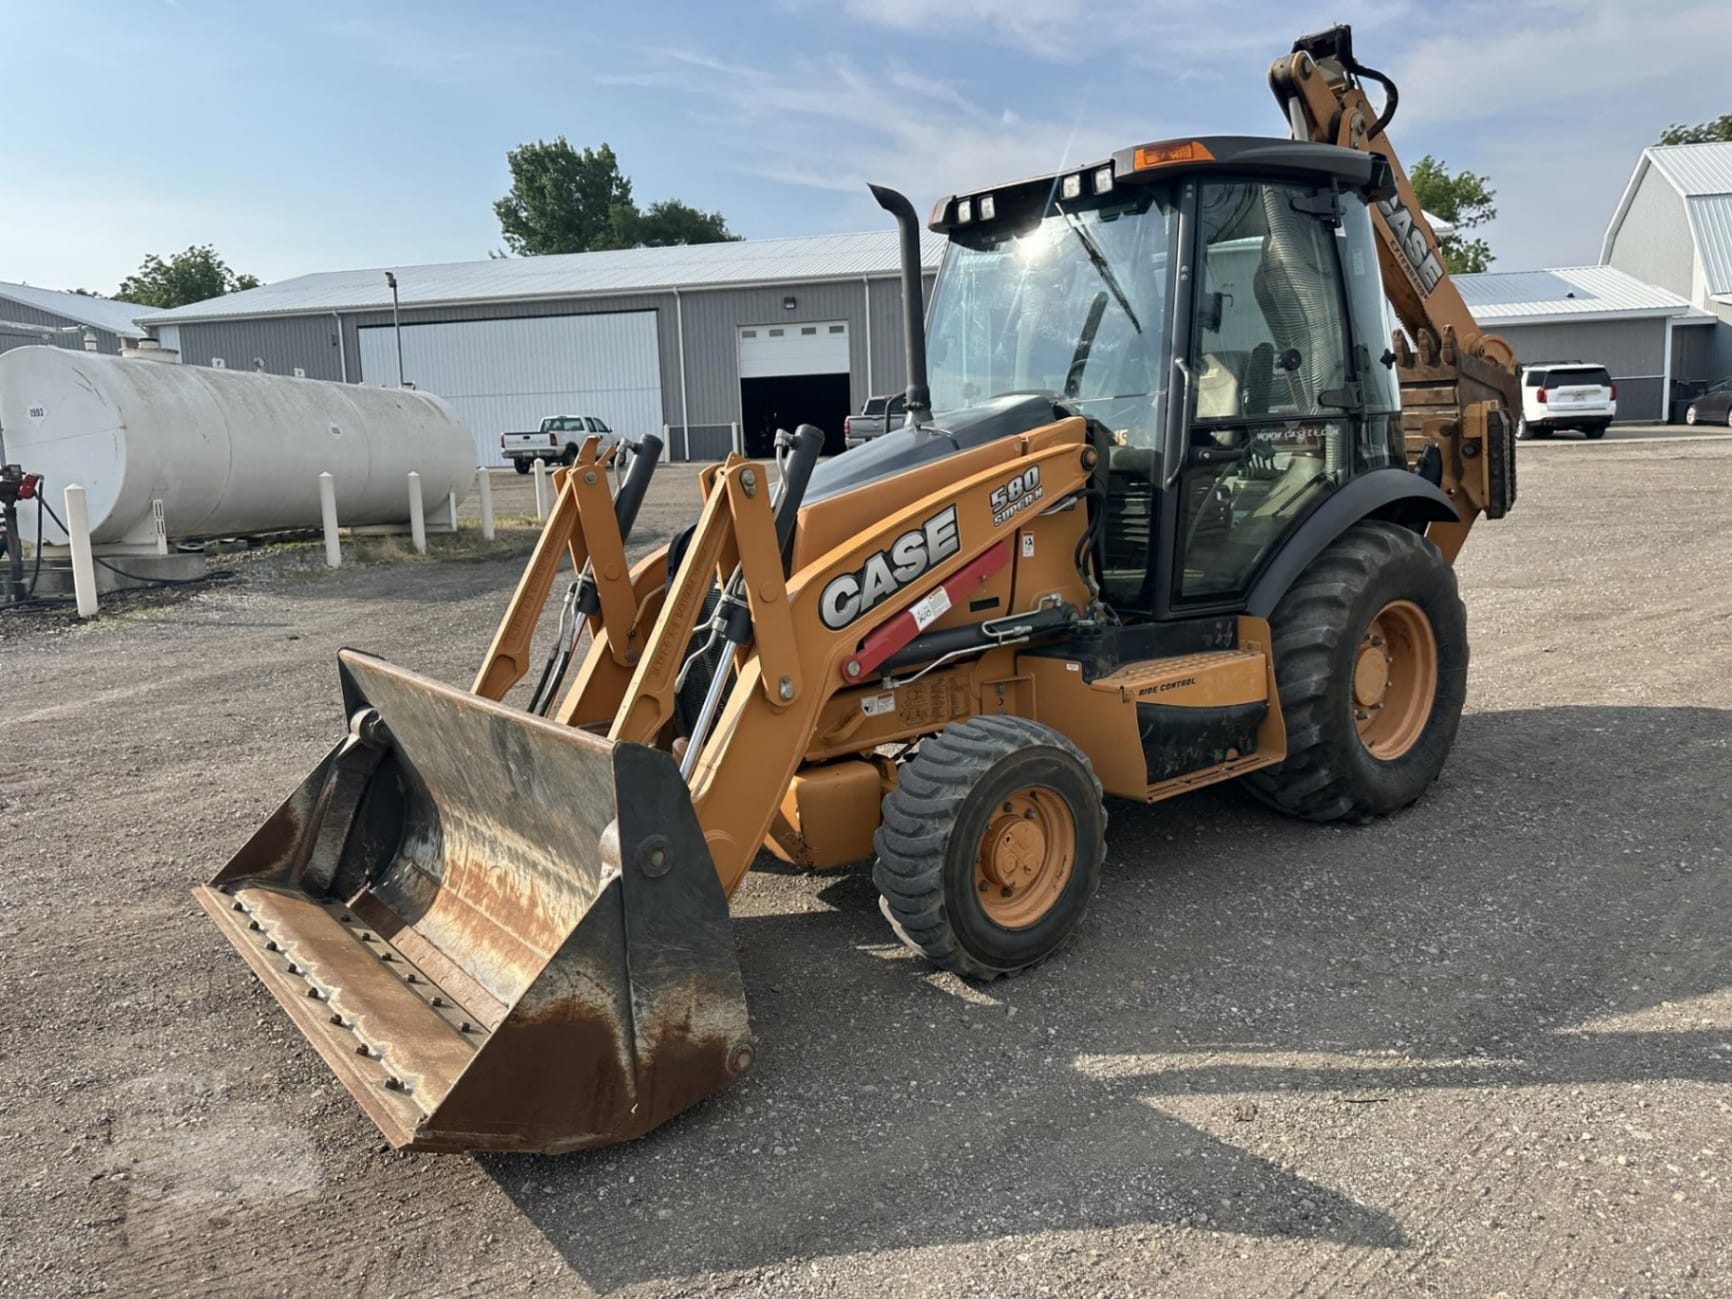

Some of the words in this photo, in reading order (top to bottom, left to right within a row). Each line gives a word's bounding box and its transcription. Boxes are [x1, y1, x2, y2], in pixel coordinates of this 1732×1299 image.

[990, 465, 1040, 514] 580
[994, 494, 1033, 527] SUPER
[819, 504, 960, 631] CASE
[1139, 686, 1157, 696] RIDE
[1160, 677, 1196, 691] CONTROL
